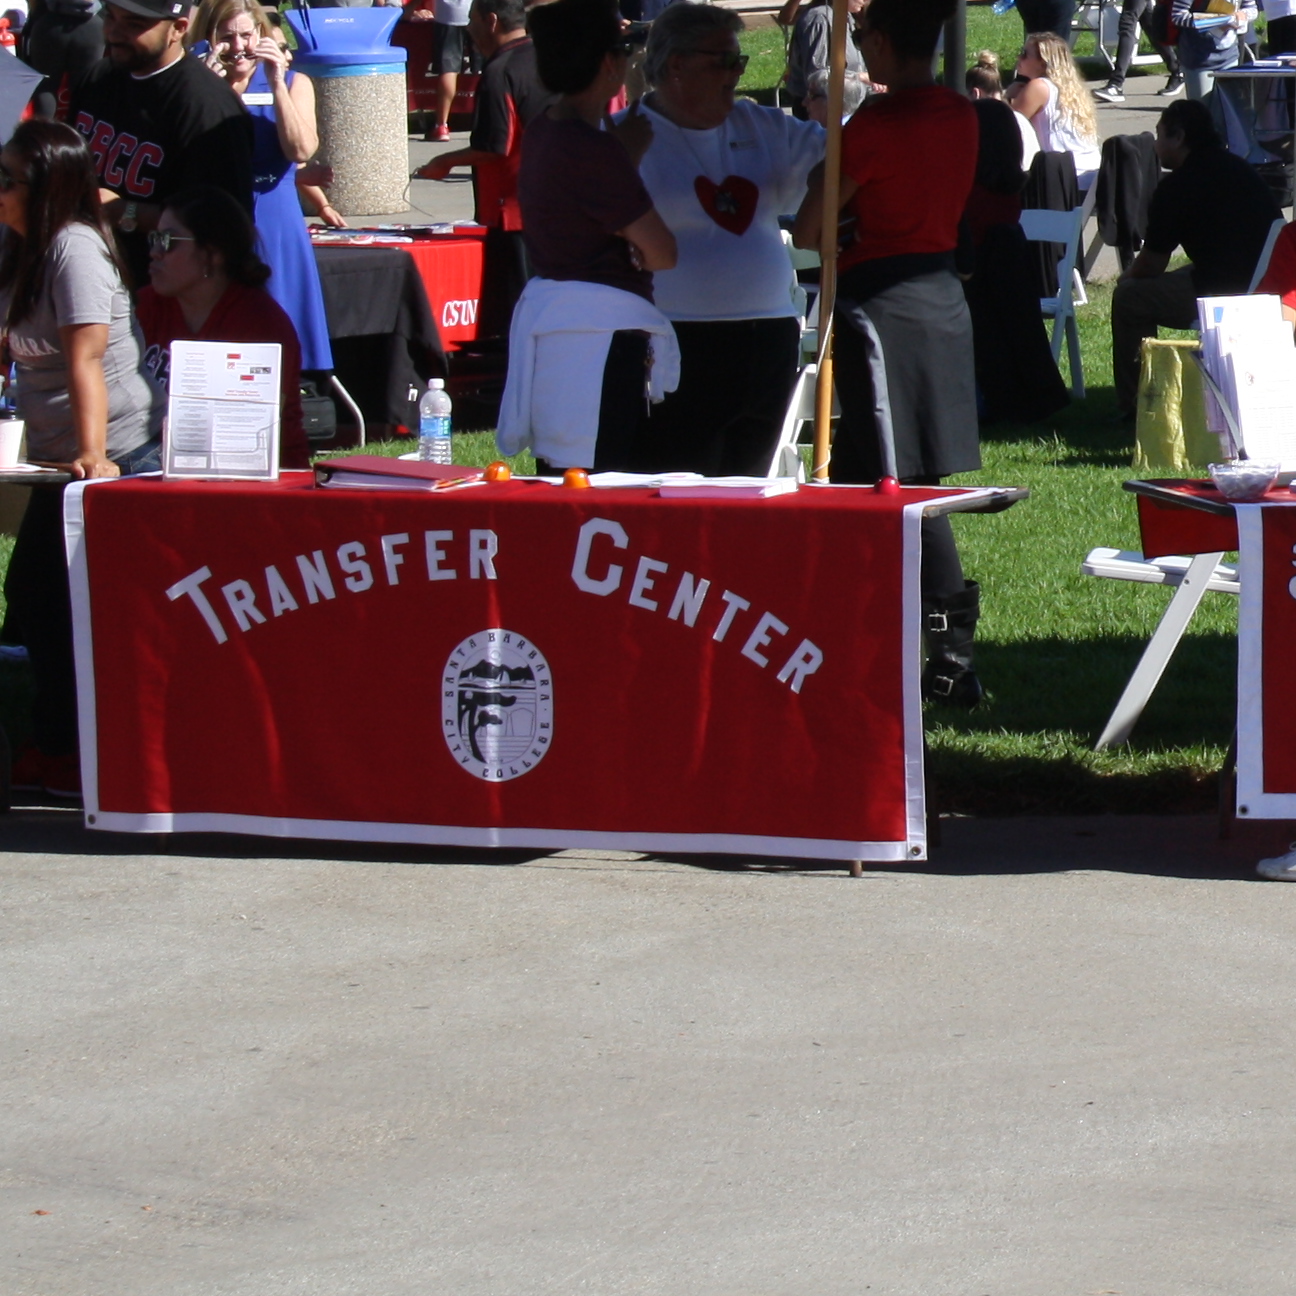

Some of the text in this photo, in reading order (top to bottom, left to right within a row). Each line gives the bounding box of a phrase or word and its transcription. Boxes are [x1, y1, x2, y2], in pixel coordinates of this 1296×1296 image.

[442, 299, 479, 327] CSUN
[165, 517, 824, 694] TRANSFER CENTER
[445, 632, 550, 701] SANTA BARBARA
[445, 719, 550, 778] CITY COLLEGE
